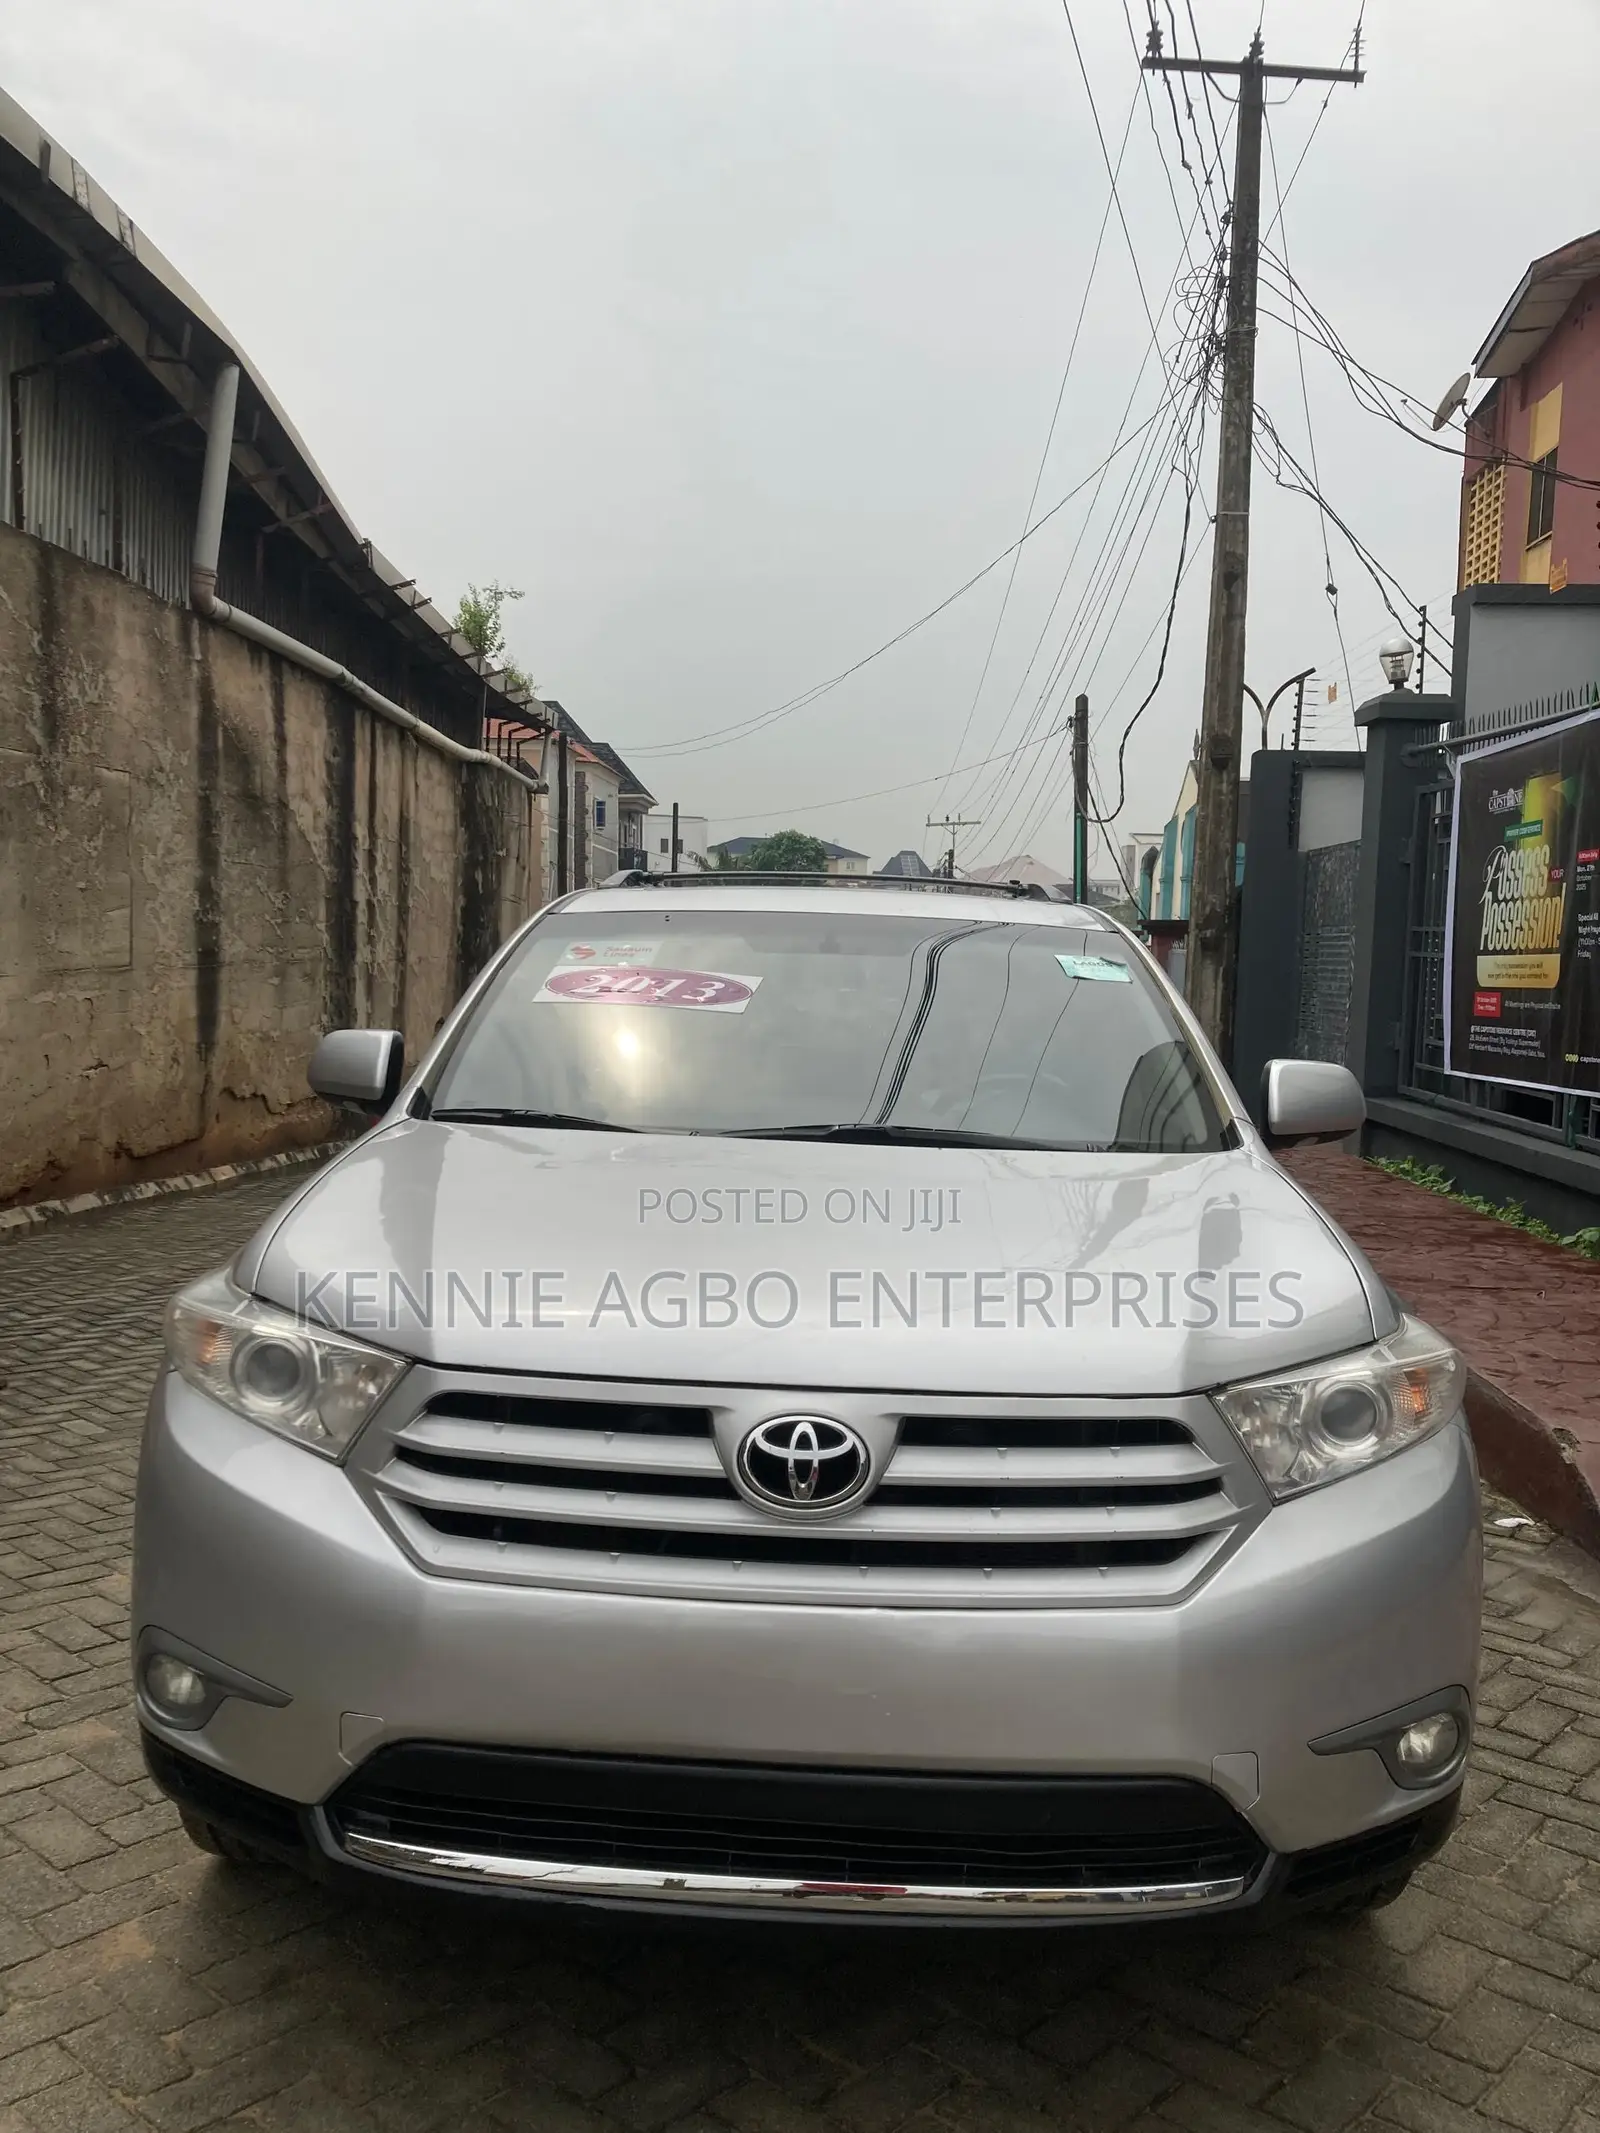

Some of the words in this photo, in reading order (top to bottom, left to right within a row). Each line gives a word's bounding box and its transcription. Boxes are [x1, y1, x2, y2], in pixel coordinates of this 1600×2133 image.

[1551, 868, 1564, 880] YOUR
[1578, 913, 1593, 923] Special
[570, 974, 726, 1003] 2013
